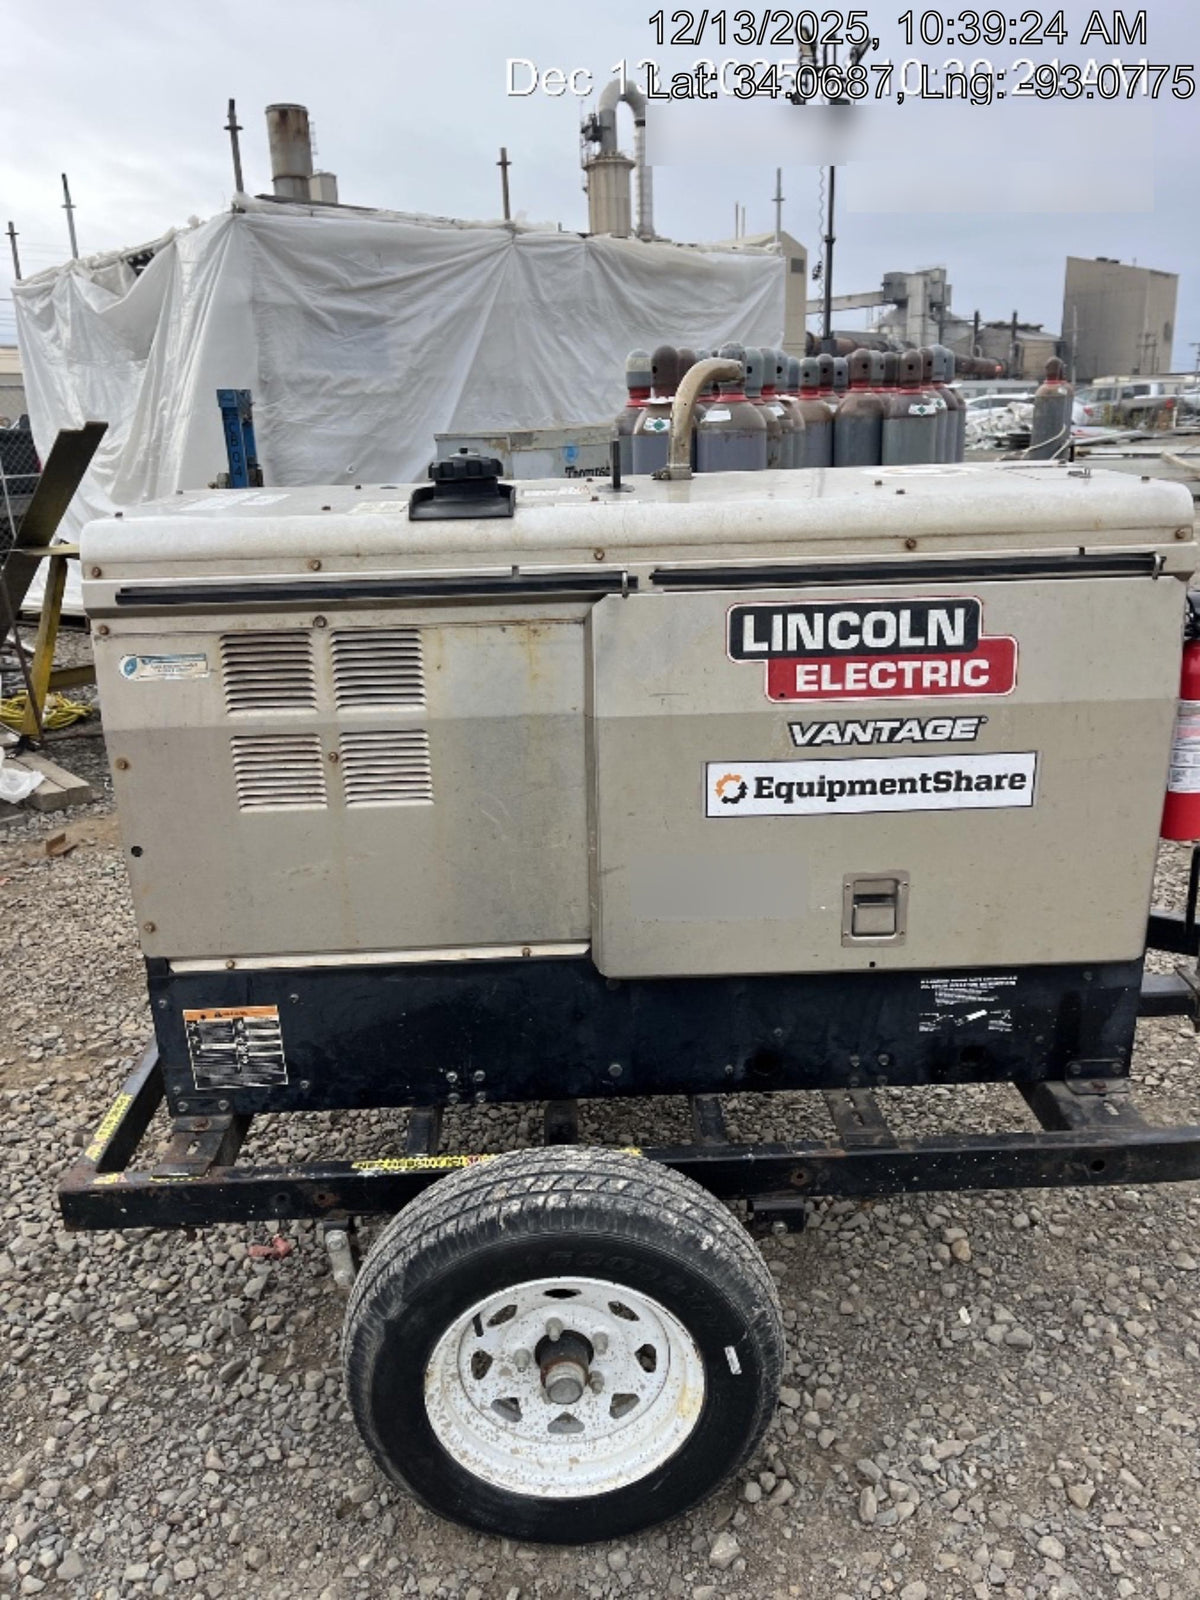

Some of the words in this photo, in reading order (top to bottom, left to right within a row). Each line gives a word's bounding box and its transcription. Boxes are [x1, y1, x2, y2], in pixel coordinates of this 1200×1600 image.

[743, 607, 966, 653] LINCOLN
[796, 658, 990, 693] ELECTRIC
[789, 715, 984, 747] VANTAGE
[753, 770, 1027, 803] EquipmentShare
